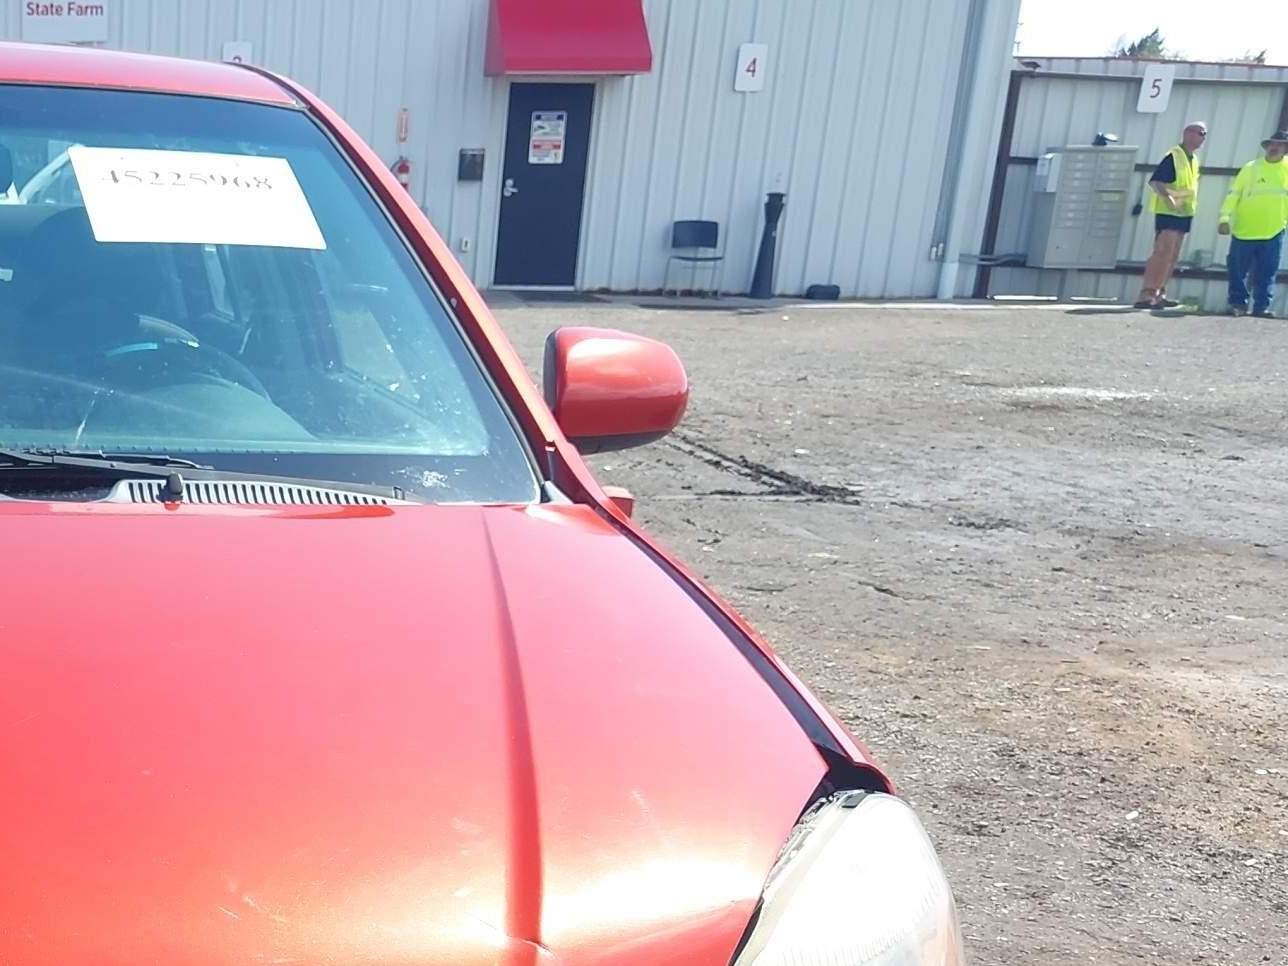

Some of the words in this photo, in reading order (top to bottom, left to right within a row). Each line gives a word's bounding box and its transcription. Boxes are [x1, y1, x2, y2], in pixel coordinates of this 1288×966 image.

[26, 2, 63, 17] State
[67, 2, 104, 17] Farm
[744, 57, 757, 78] 4
[1149, 78, 1162, 99] 5
